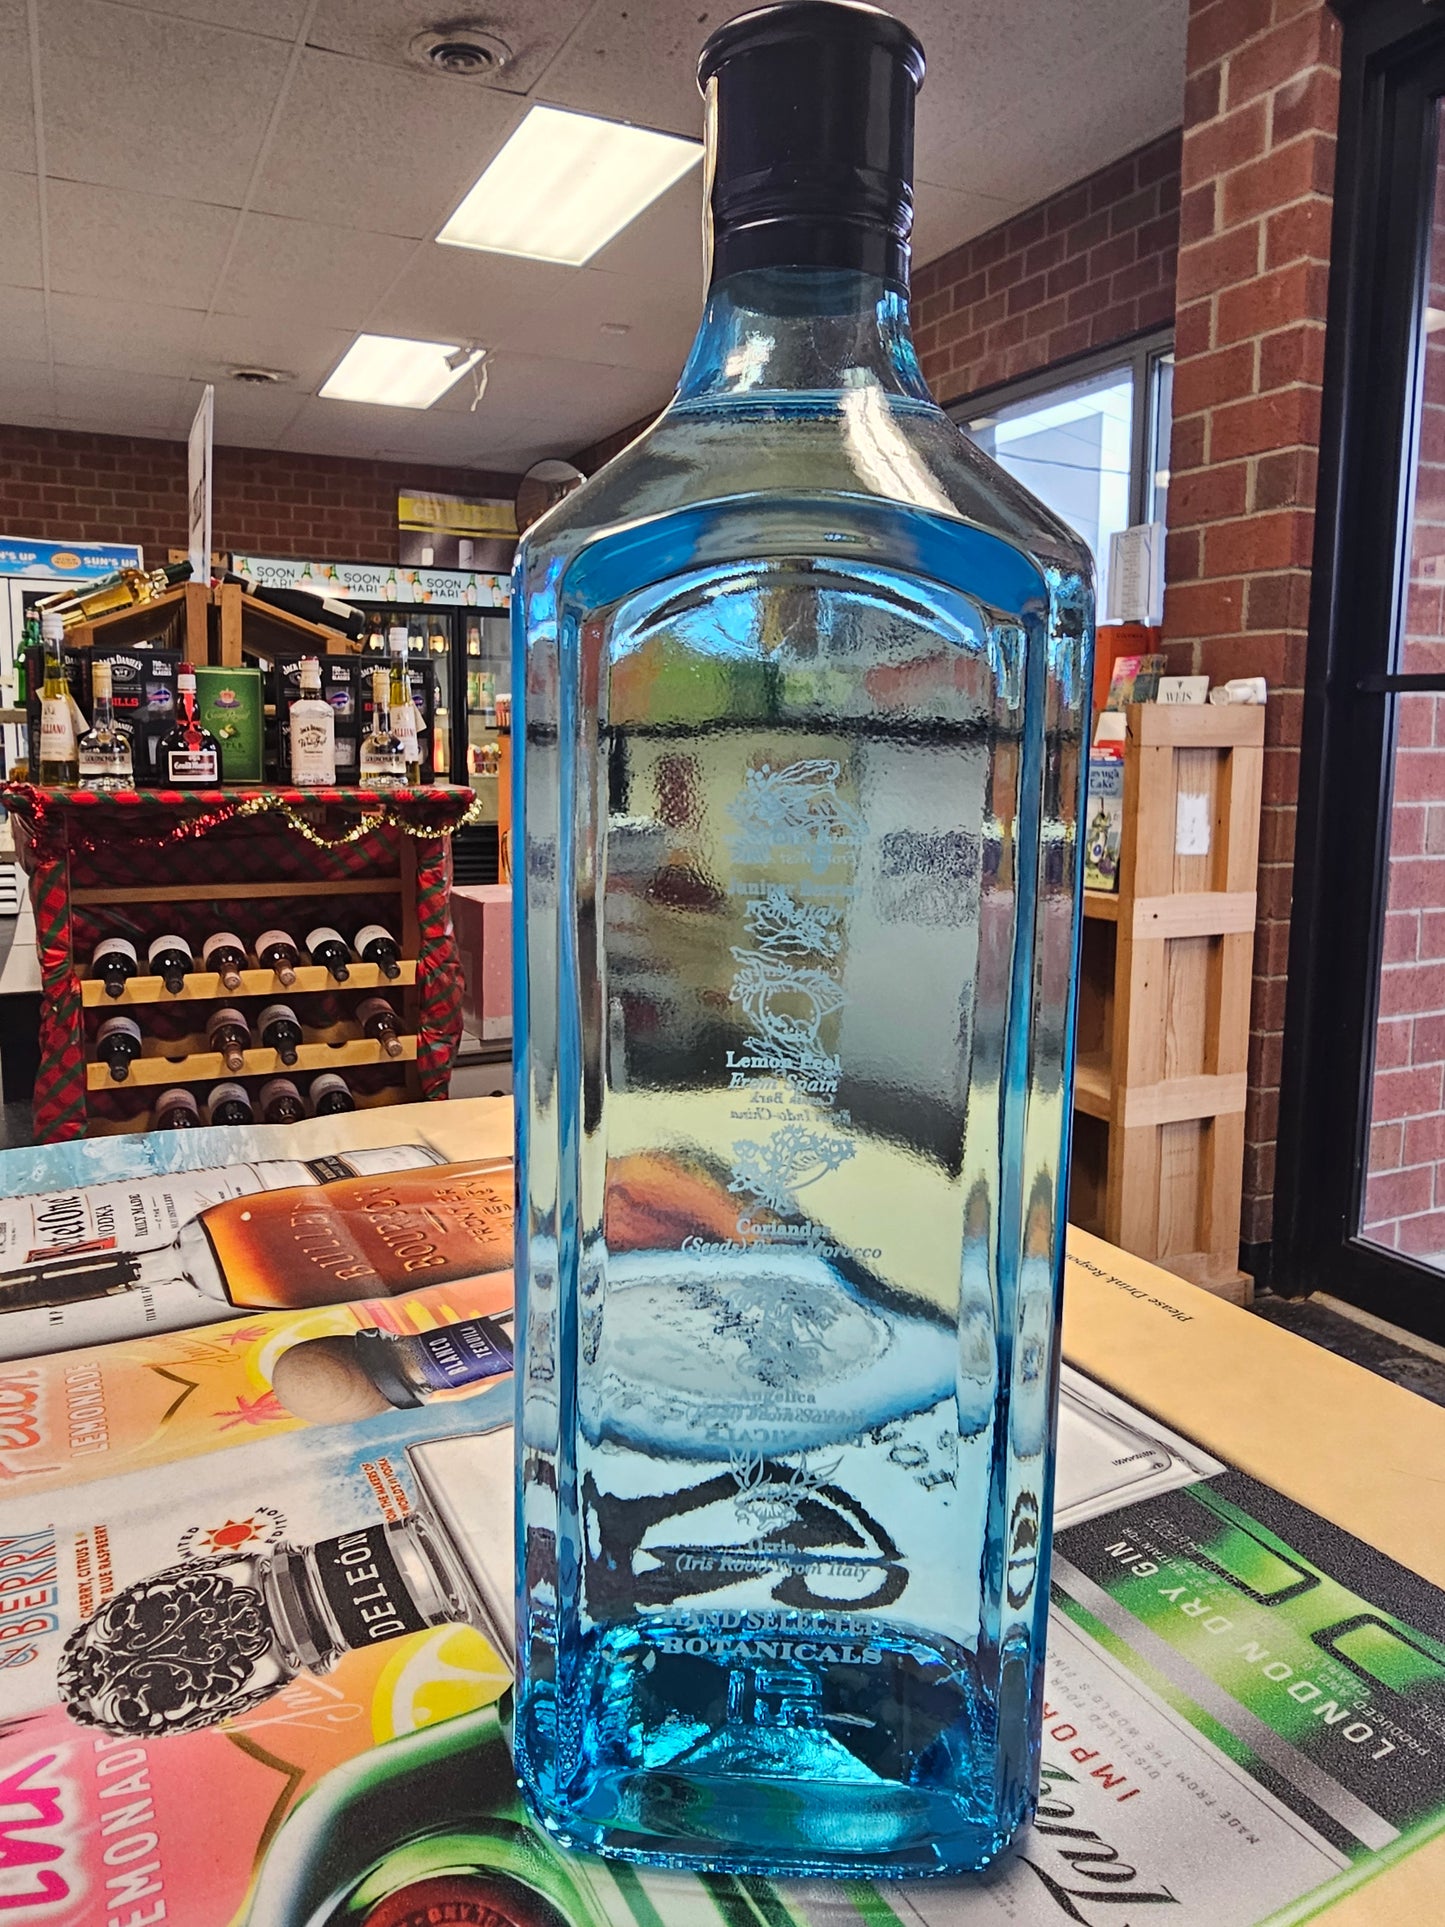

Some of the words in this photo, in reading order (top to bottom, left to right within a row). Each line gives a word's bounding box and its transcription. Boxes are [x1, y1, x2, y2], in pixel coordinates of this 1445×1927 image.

[256, 566, 295, 579] SOON
[343, 572, 381, 584] SOON
[426, 578, 461, 590] SOON
[725, 1050, 792, 1069] Lemon
[784, 1073, 839, 1093] Spain
[1105, 1275, 1148, 1299] Drink
[1147, 1297, 1195, 1323] Please
[428, 1336, 469, 1377] BLANCO
[459, 1324, 493, 1359] TEQUILA
[63, 1358, 111, 1459] LEMONADE
[255, 1506, 288, 1545] EDITION
[75, 1546, 92, 1578] CITRUS
[93, 1524, 112, 1570] RASPBERRY
[1103, 1540, 1160, 1578] GIN
[99, 1570, 114, 1595] BLUE
[675, 1553, 714, 1573] (Iris
[775, 1558, 823, 1576] From
[826, 1561, 871, 1582] Italy
[662, 1606, 742, 1630] HAND
[745, 1608, 886, 1637] SELECTED
[1157, 1586, 1234, 1635] DRY
[660, 1635, 885, 1665] BOTANICALS
[1237, 1640, 1396, 1760] LONDON
[1352, 1699, 1432, 1757] PRODUCED
[1143, 1742, 1172, 1768] THE
[1175, 1771, 1216, 1807] FROM
[94, 1736, 169, 1927] EMONADE
[1217, 1810, 1261, 1845] MADE
